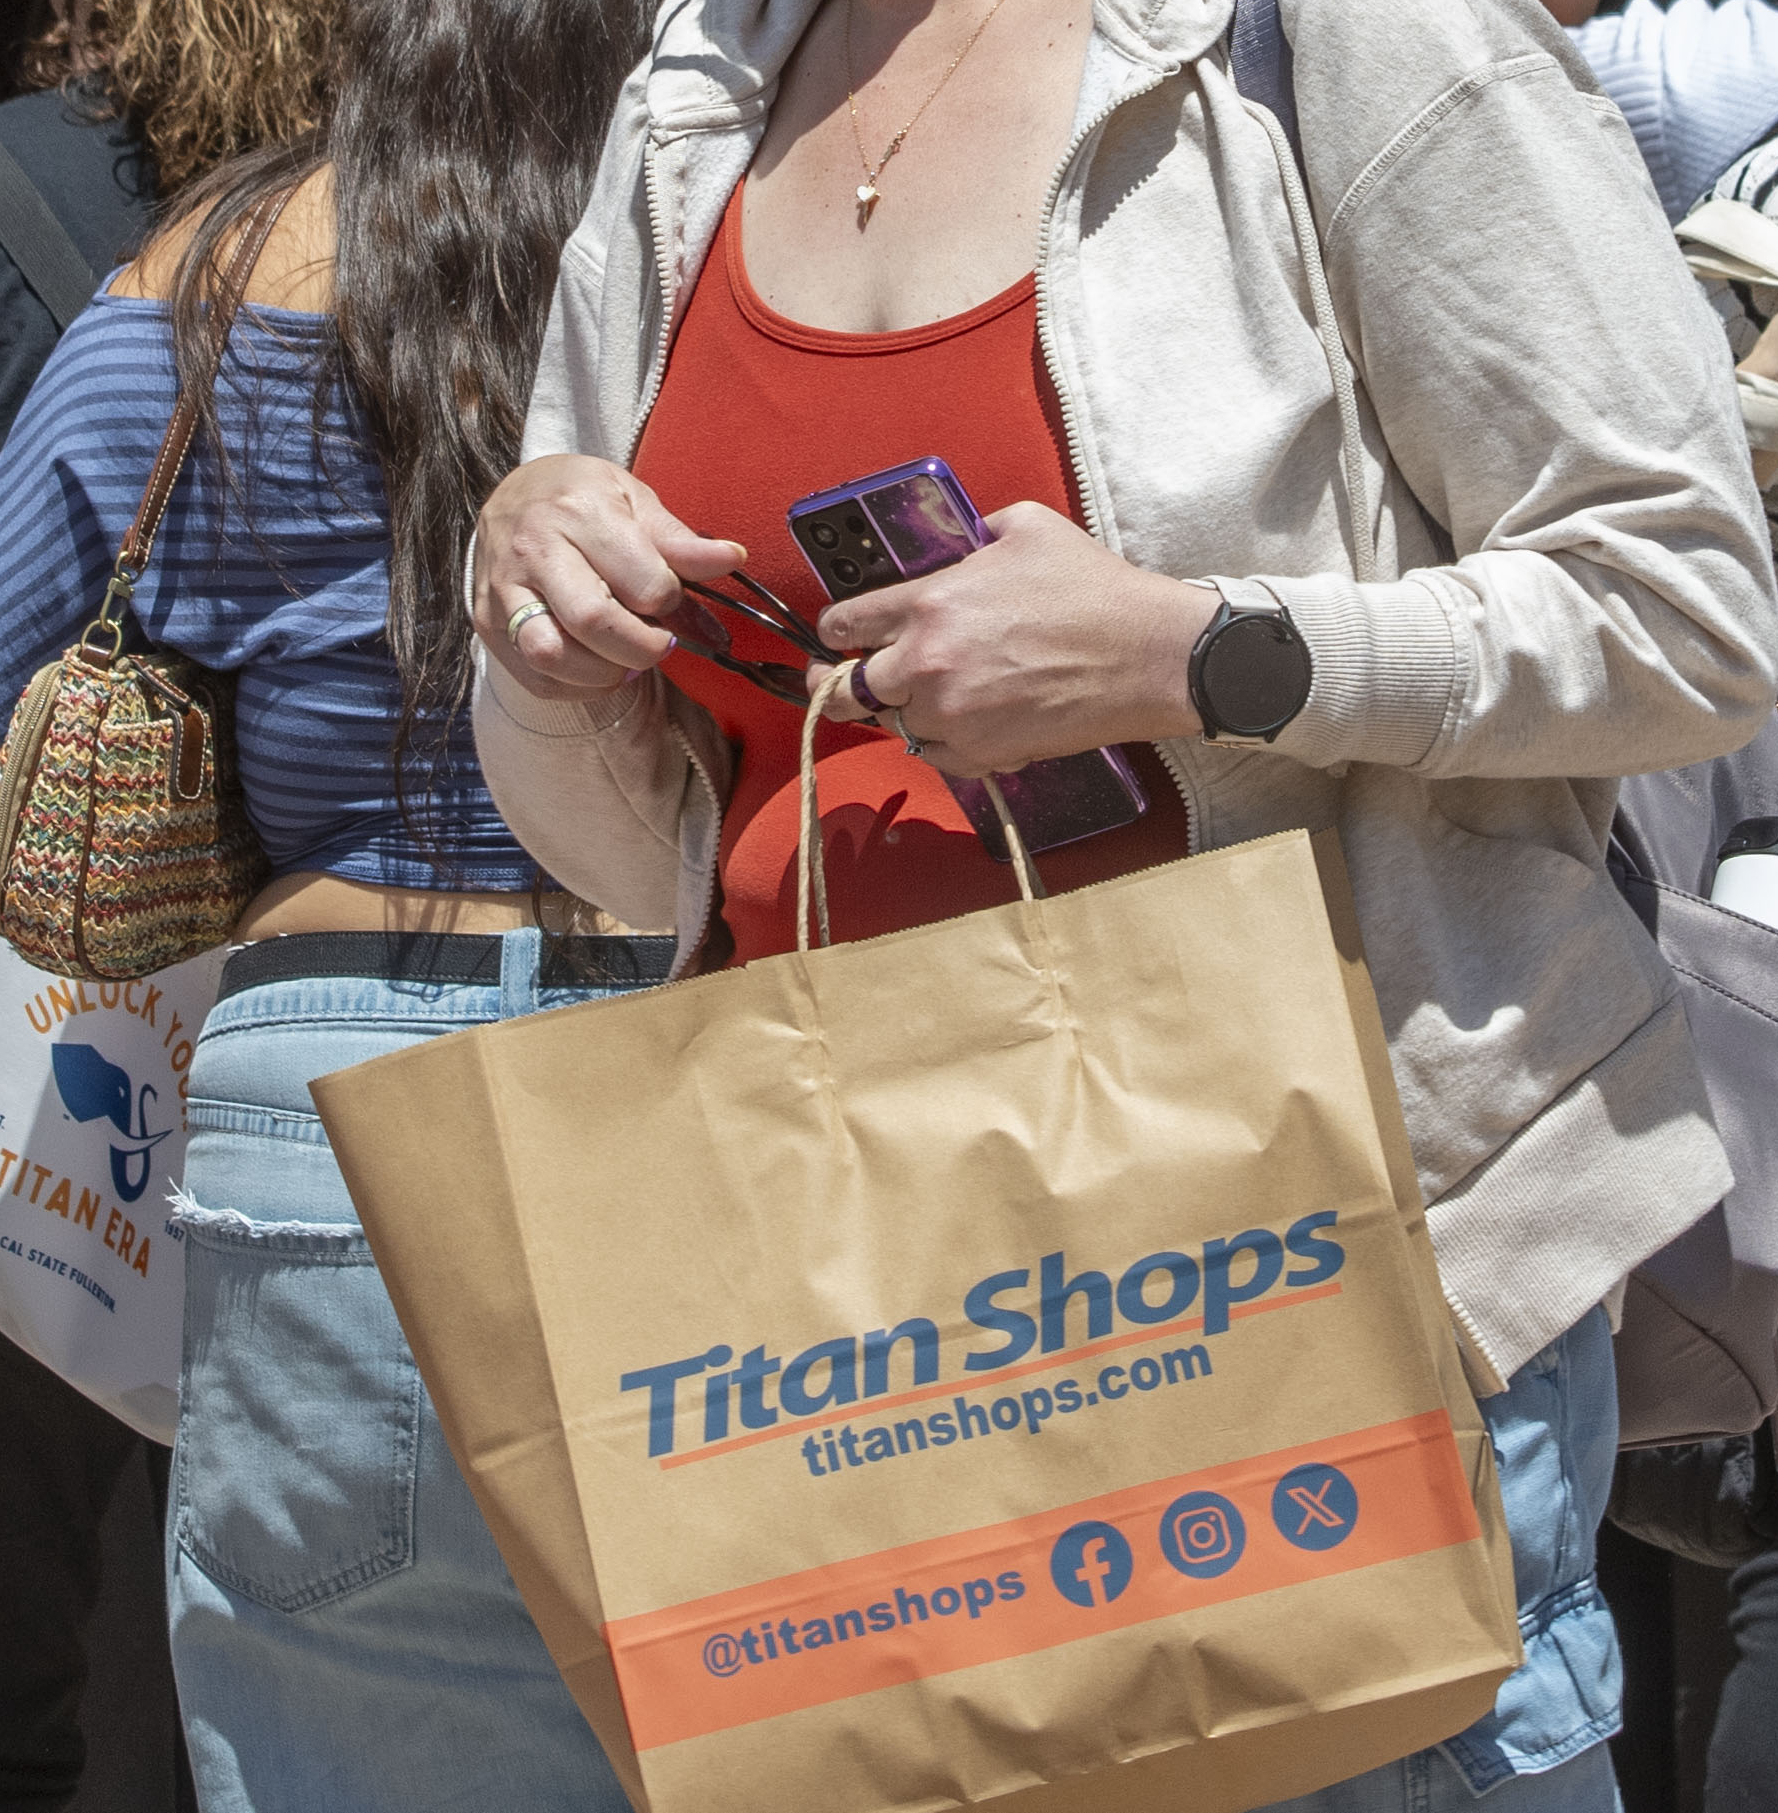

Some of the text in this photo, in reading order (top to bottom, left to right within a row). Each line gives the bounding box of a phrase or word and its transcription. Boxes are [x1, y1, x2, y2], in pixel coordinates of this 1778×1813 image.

[25, 978, 164, 1035] UNLOCK
[0, 1235, 24, 1257] CAL
[27, 1248, 69, 1278] STATE
[102, 1205, 152, 1279] ERA
[620, 1210, 1347, 1459] Titan Shops
[801, 1343, 1214, 1478] titanshops.com
[702, 1569, 1027, 1679] @titanshops
